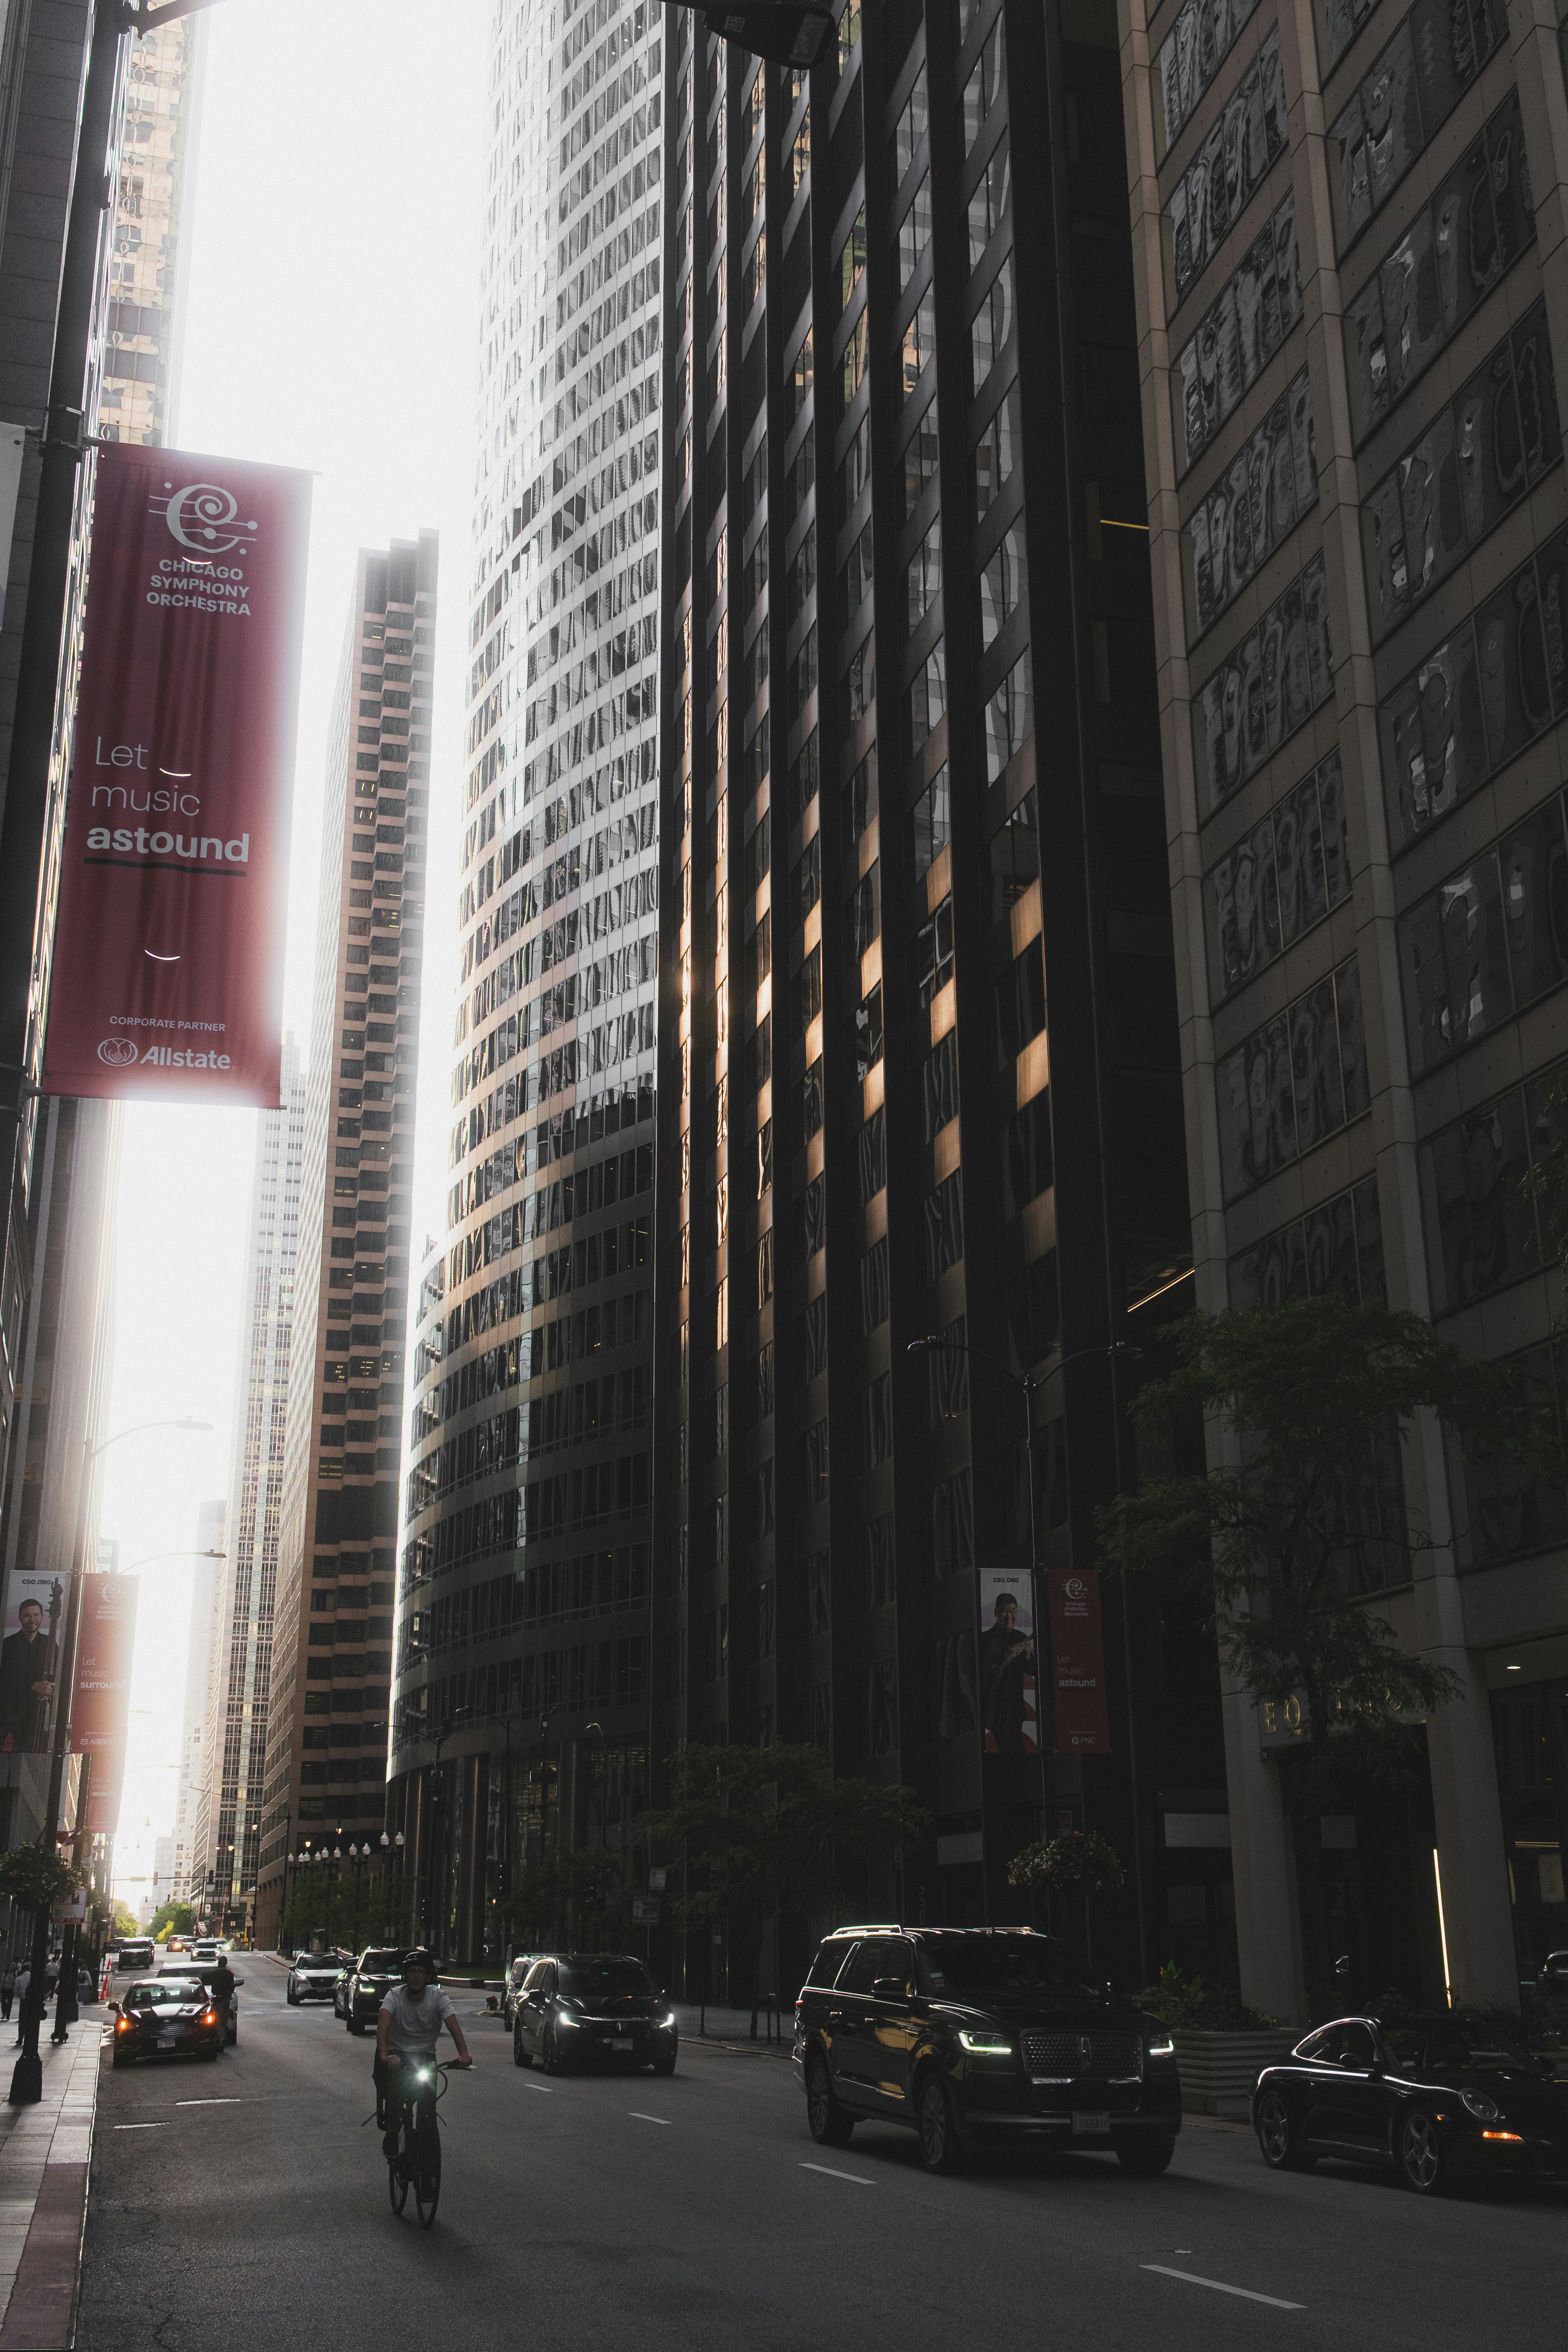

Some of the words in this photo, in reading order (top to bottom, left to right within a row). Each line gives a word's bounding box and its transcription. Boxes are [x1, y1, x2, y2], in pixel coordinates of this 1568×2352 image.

[727, 17, 736, 30] LED
[159, 559, 243, 581] CHICAGO
[151, 575, 249, 598] SYMPHONY
[146, 592, 251, 616] ORCHESTRA
[96, 736, 148, 769] Let
[92, 785, 200, 816] music
[87, 827, 249, 862] astound
[110, 1016, 175, 1029] CORPORATE
[178, 1021, 225, 1031] PARTNER
[140, 1046, 230, 1069] Allstate
[83, 1657, 96, 1665] Let
[1058, 1654, 1070, 1663] Let
[1059, 1678, 1096, 1686] astound
